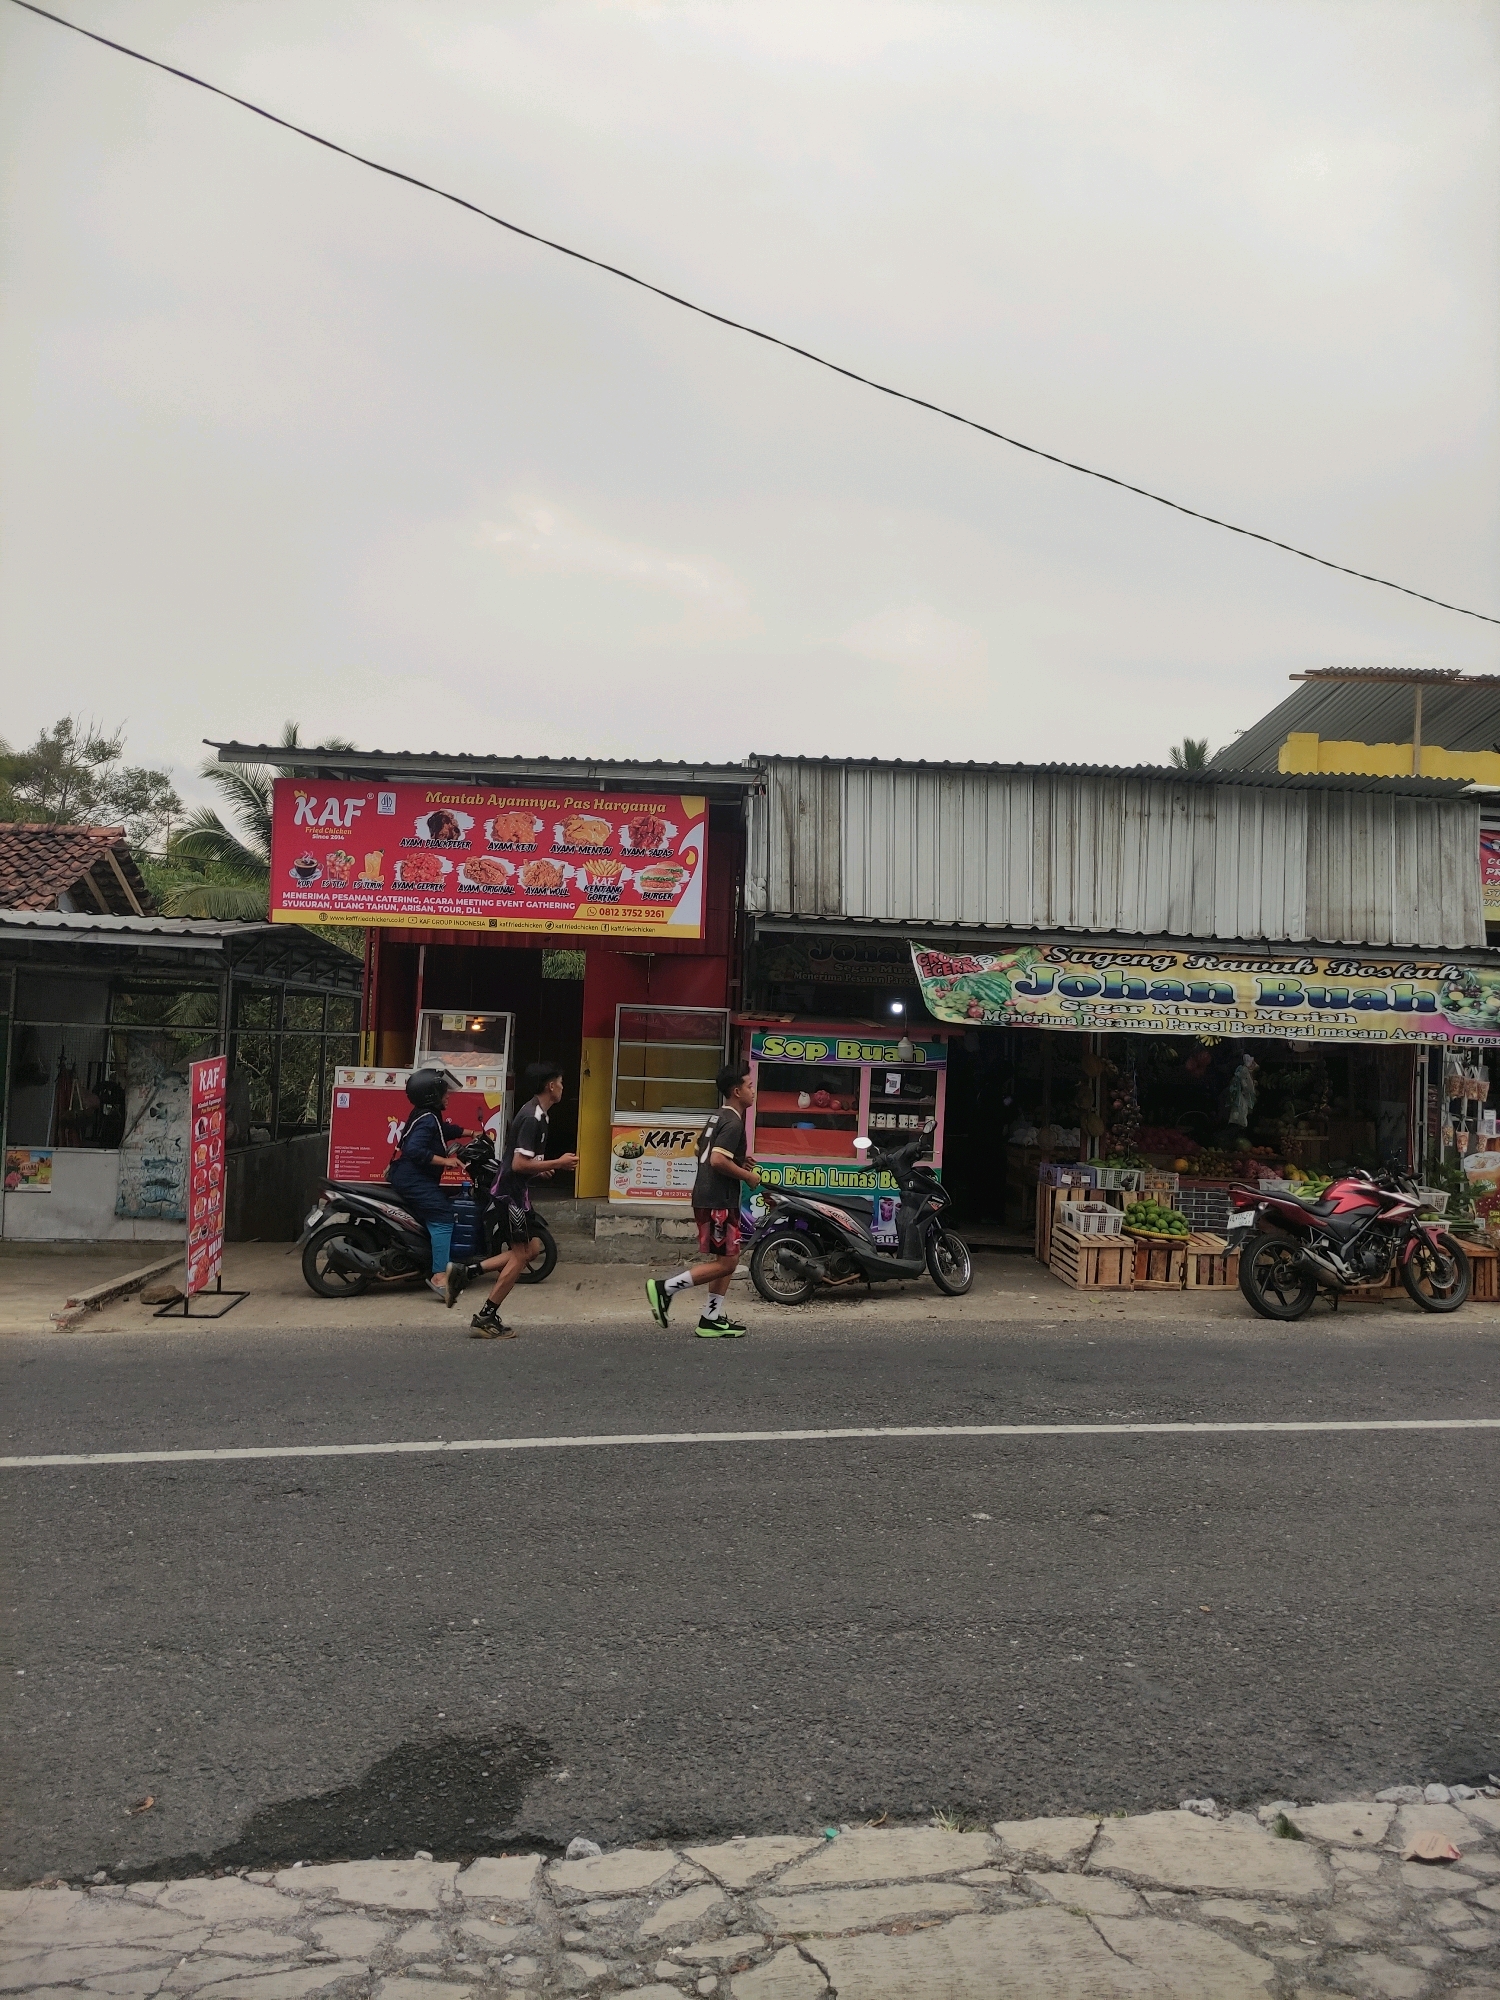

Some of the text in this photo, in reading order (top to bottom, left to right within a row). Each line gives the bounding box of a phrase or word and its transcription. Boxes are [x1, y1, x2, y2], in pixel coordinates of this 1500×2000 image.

[425, 791, 667, 814] Mantab Ayamnya, Pas Harganya
[294, 797, 366, 827] KAF
[324, 827, 352, 835] Chicken
[400, 838, 423, 848] AYAM
[487, 842, 513, 851] AYAM
[550, 844, 576, 854] AYAM
[620, 847, 646, 857] AYAM
[296, 880, 314, 888] KOPI
[391, 882, 445, 892] AYAM GEPREK
[457, 884, 515, 895] AYAM ORIGINAL
[584, 885, 622, 894] KENTANG
[524, 886, 548, 895] AYAM
[282, 892, 576, 910] MENERIMA PESANAN CATERING, ACARA MEETING EVENT GATHERING
[587, 893, 619, 902] GORENG
[642, 892, 674, 901] BURGER
[282, 900, 482, 914] SYUKURAN, ULANG TAHUN, ARISAN, TOUR, DLL
[599, 907, 665, 918] 0812 3752 9261
[834, 963, 876, 973] Segar
[1044, 946, 1464, 980] Sugeng Rawuh Boskuh
[794, 971, 842, 982] Menerima
[845, 974, 884, 984] Pesanan
[1013, 965, 1438, 1013] Johan Buah
[1060, 1000, 1357, 1024] Segar Murah Meriah
[982, 1009, 1449, 1042] Menerima Pesanan Parcel Berbagai macam Acara
[1457, 1036, 1474, 1044] HP.
[763, 1036, 828, 1061] Sop
[199, 1067, 220, 1092] KAF
[644, 1130, 696, 1150] KAFF
[783, 1166, 827, 1188] Buah
[828, 1167, 877, 1189] Lunas
